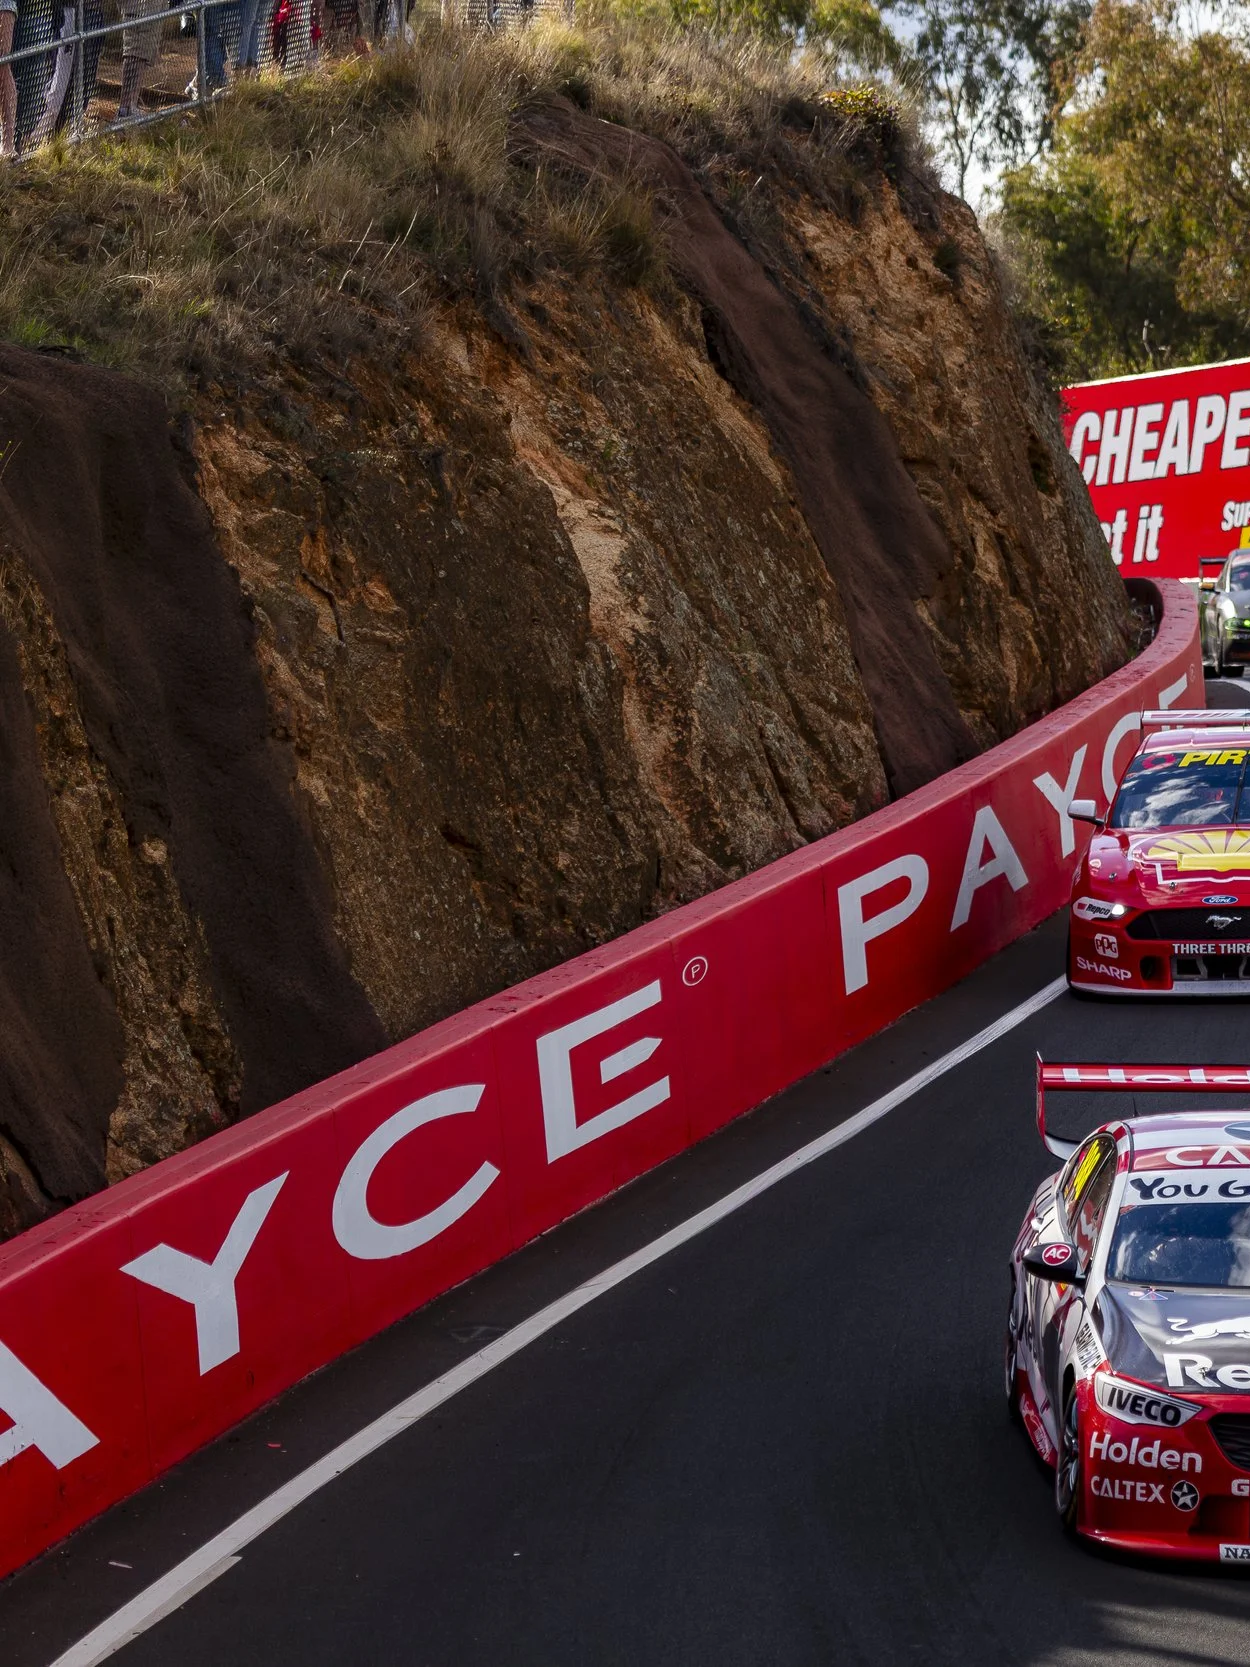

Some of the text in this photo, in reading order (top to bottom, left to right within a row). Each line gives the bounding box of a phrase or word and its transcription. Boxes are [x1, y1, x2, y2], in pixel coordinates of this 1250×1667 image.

[1132, 504, 1164, 563] it
[1086, 903, 1111, 915] Repco
[1095, 935, 1118, 955] PPG
[1172, 943, 1216, 954] THREE
[1076, 956, 1132, 981] SHARP
[1044, 1247, 1068, 1260] AC
[1107, 1386, 1181, 1427] IVECO
[1089, 1431, 1203, 1474] Holden
[1090, 1475, 1166, 1504] CALTEX
